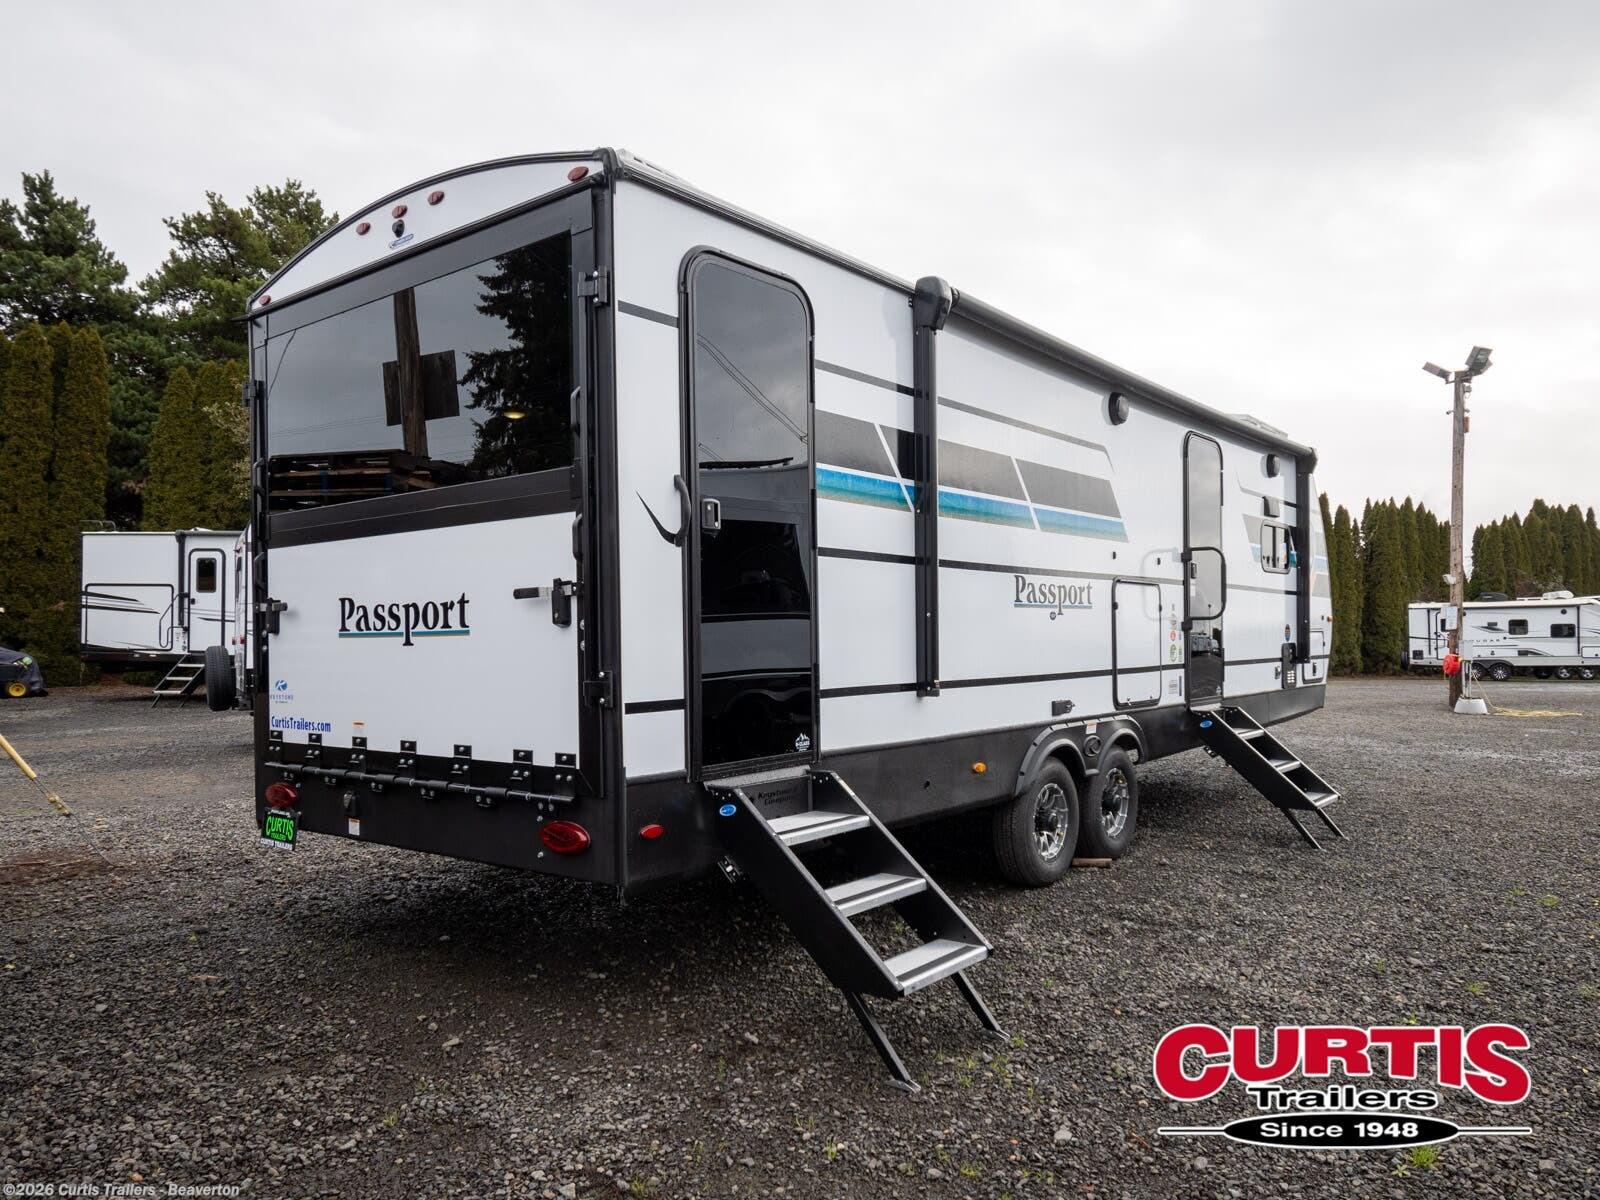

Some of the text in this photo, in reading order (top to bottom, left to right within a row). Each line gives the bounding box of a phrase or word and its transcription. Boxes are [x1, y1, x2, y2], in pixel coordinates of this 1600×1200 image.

[1014, 575, 1093, 615] Passport
[338, 592, 470, 646] Passport
[271, 716, 331, 733] CurtisTrailers.com
[265, 815, 294, 841] CURTIS
